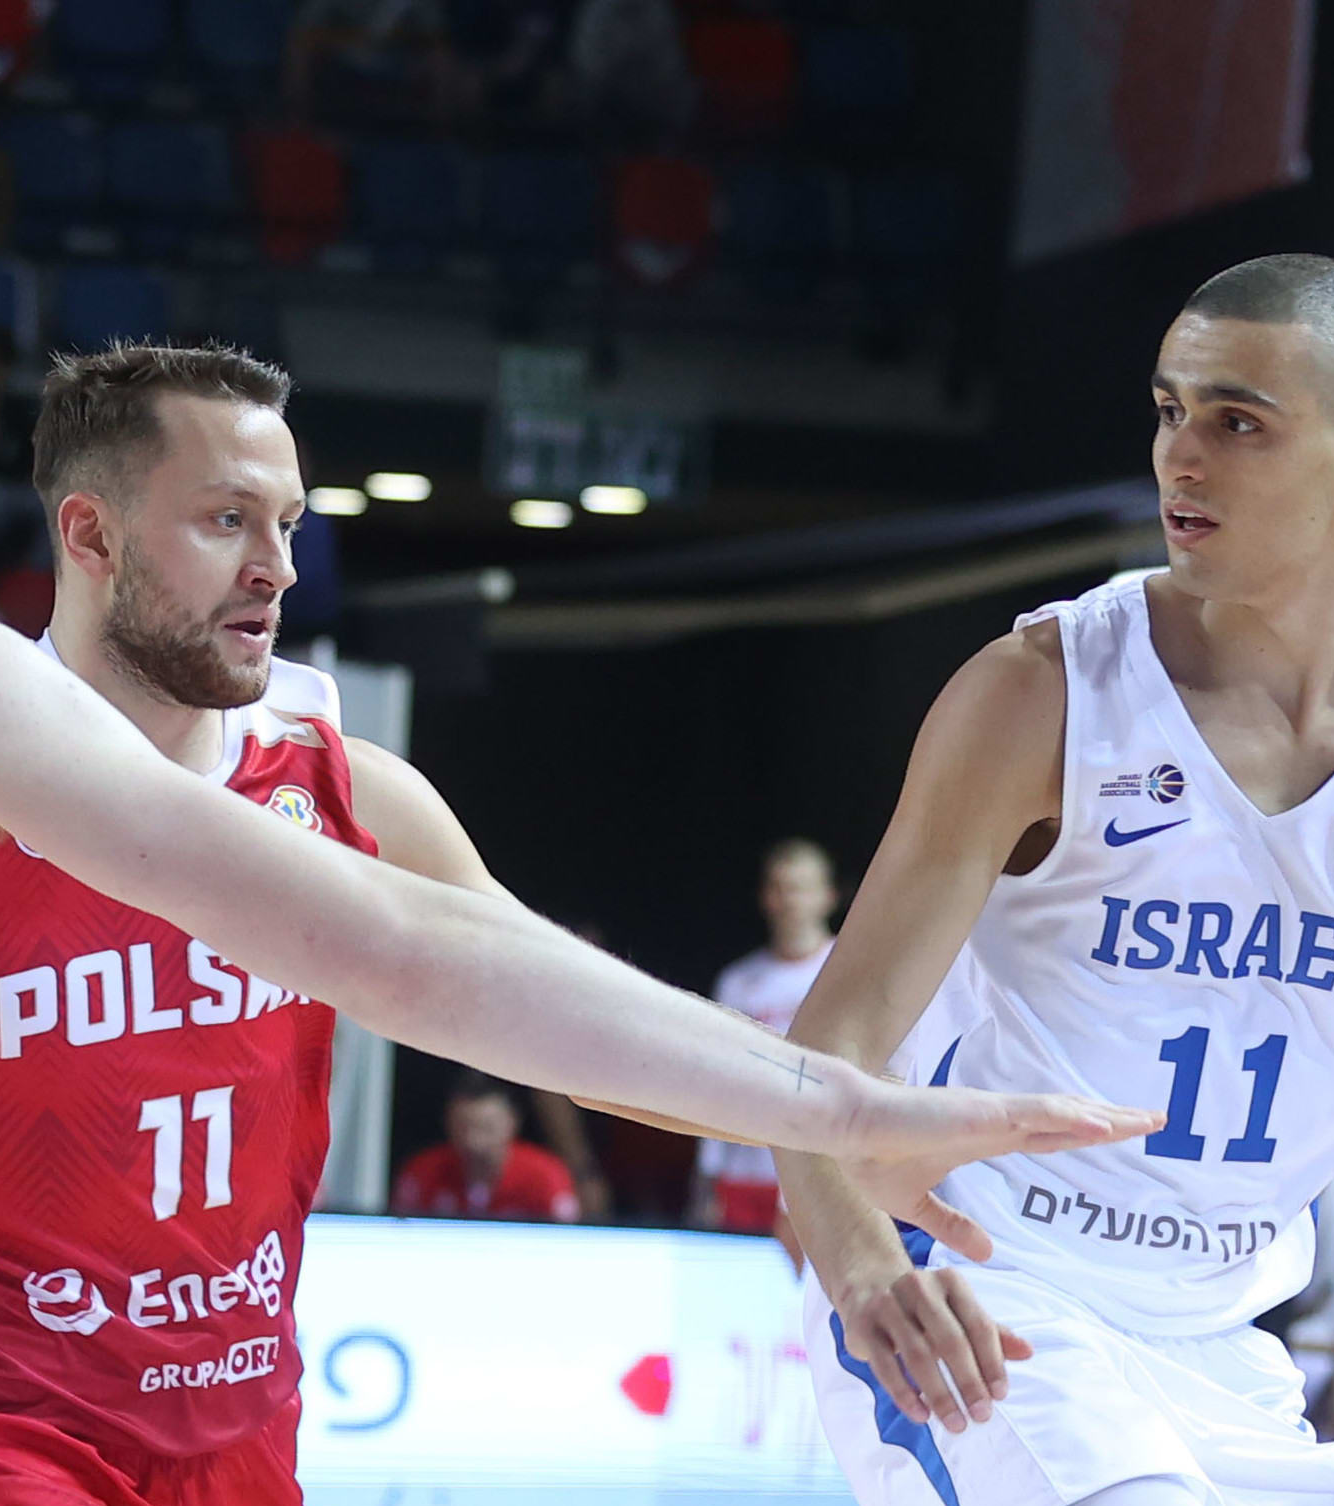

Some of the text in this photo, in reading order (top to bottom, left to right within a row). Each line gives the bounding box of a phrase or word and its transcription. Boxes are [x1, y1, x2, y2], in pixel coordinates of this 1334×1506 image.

[1144, 1025, 1289, 1163] 11
[136, 1084, 235, 1222] 11
[1020, 1184, 1210, 1253] הפועלים
[139, 1356, 229, 1393] GRUPA
